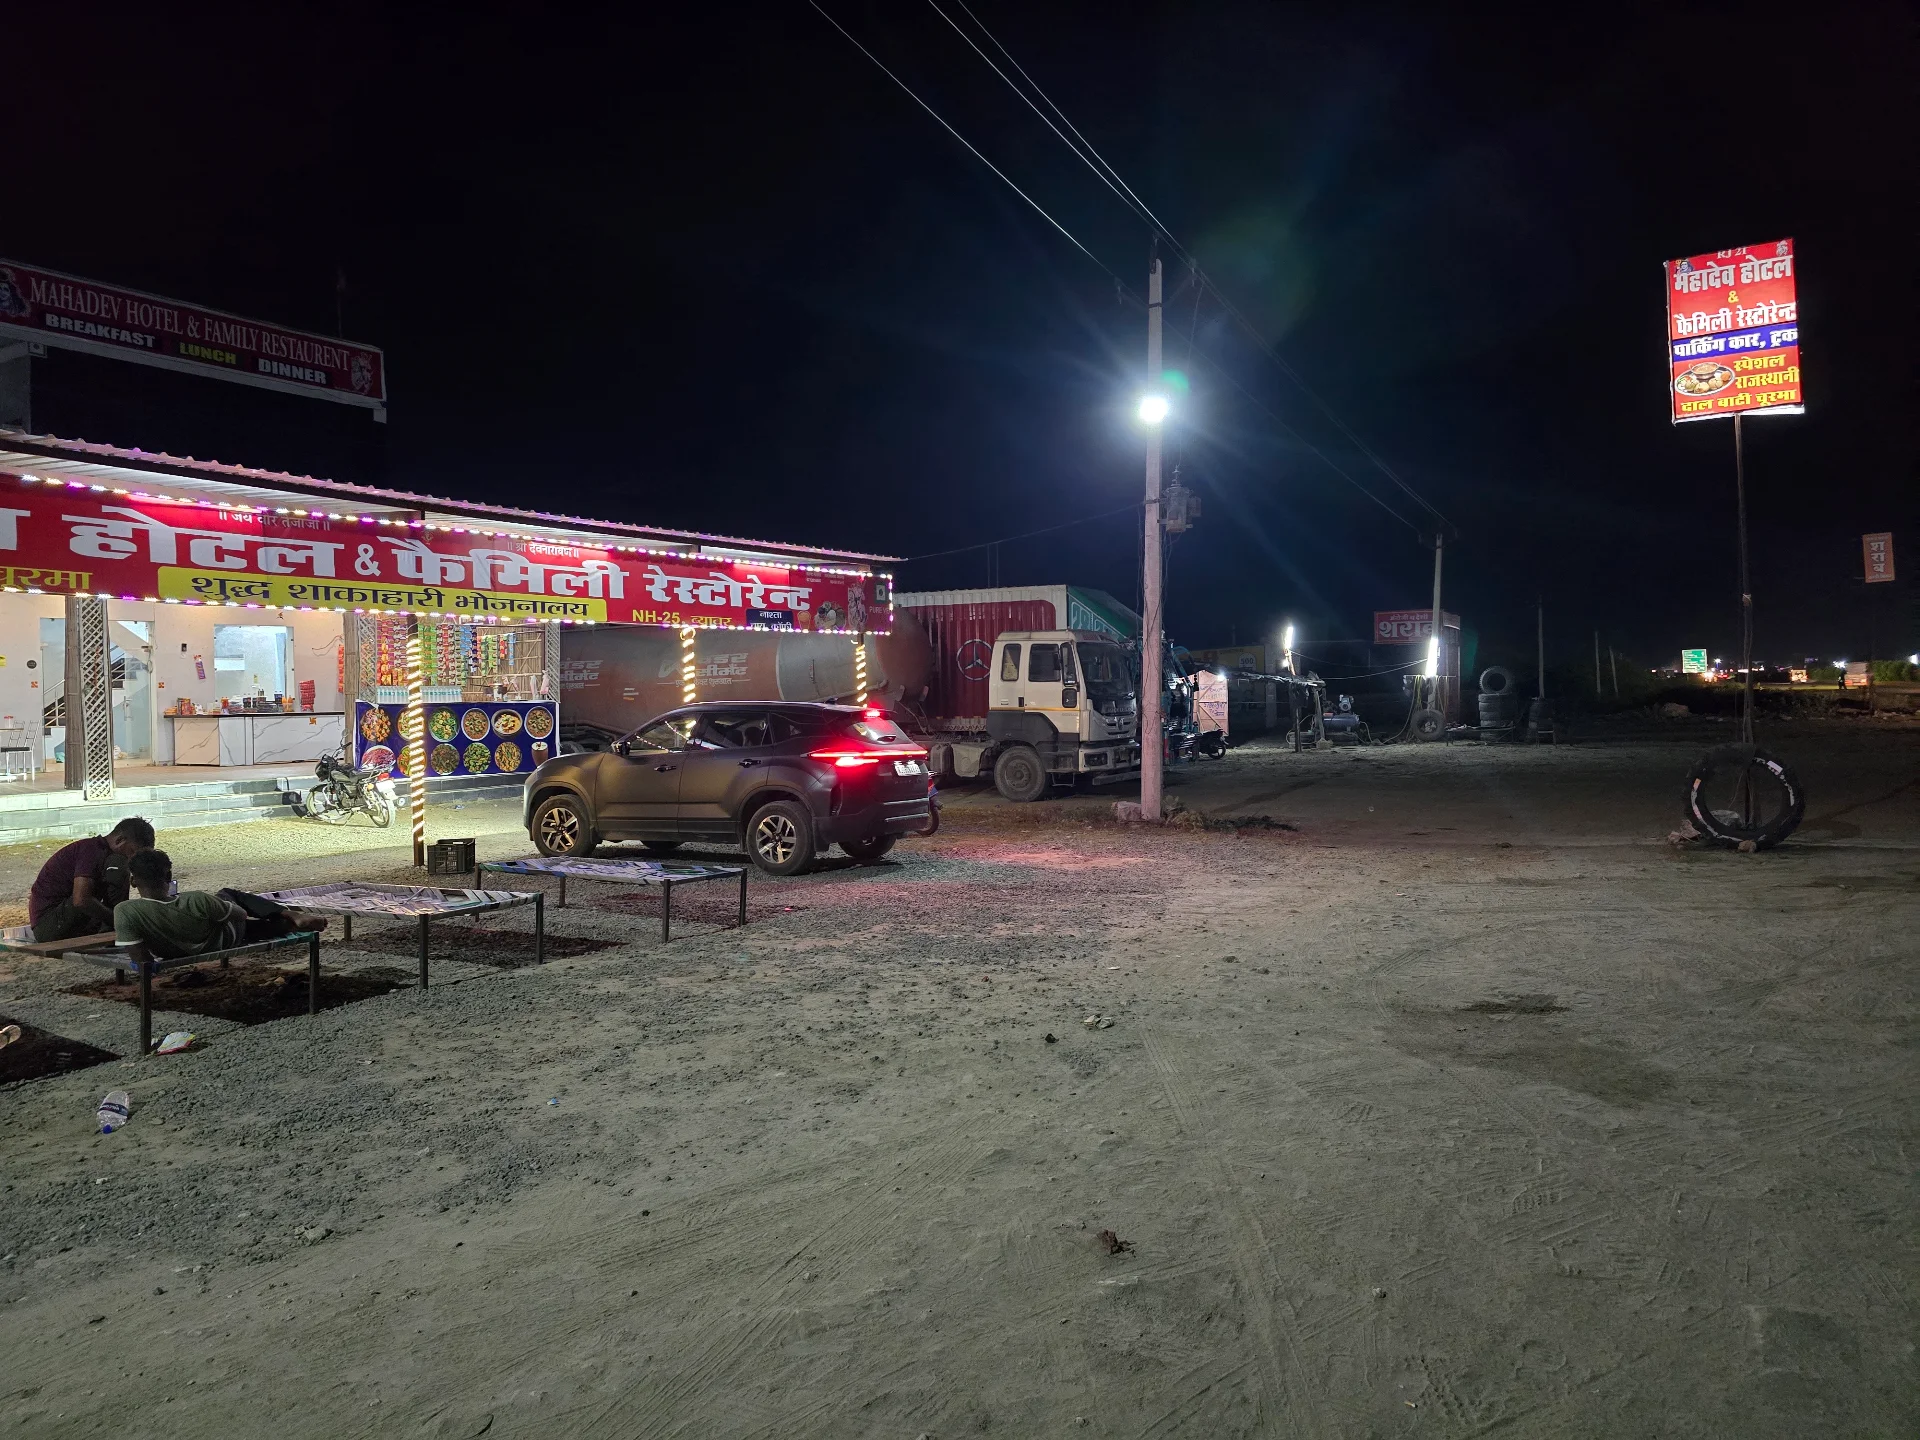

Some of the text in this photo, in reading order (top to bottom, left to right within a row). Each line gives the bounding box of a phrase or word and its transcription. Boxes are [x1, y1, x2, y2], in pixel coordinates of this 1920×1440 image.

[1673, 254, 1793, 294] महादेव होटल
[1727, 290, 1740, 304] &
[29, 276, 350, 372] MAHADEV HOTEL & FAMILY RESTAURENT
[45, 312, 156, 349] BREAKFAST
[1673, 299, 1797, 336] फैमिली रेस्टोरेन्ट
[179, 341, 237, 366] LUNCH
[1733, 353, 1787, 369] स्पेशल
[258, 357, 327, 386] DINNER
[1735, 367, 1800, 389] राजस्थानी
[1681, 388, 1797, 413] दाल बाटी चूरमा
[231, 511, 252, 524] जय
[62, 505, 345, 577] होटल
[354, 543, 382, 577] &
[379, 534, 629, 600] फैमिली
[645, 564, 813, 611] रेस्टोरेन्ट
[191, 575, 589, 617] शुद्ध शाकाहारी भोजनालय
[869, 605, 883, 615] PURE
